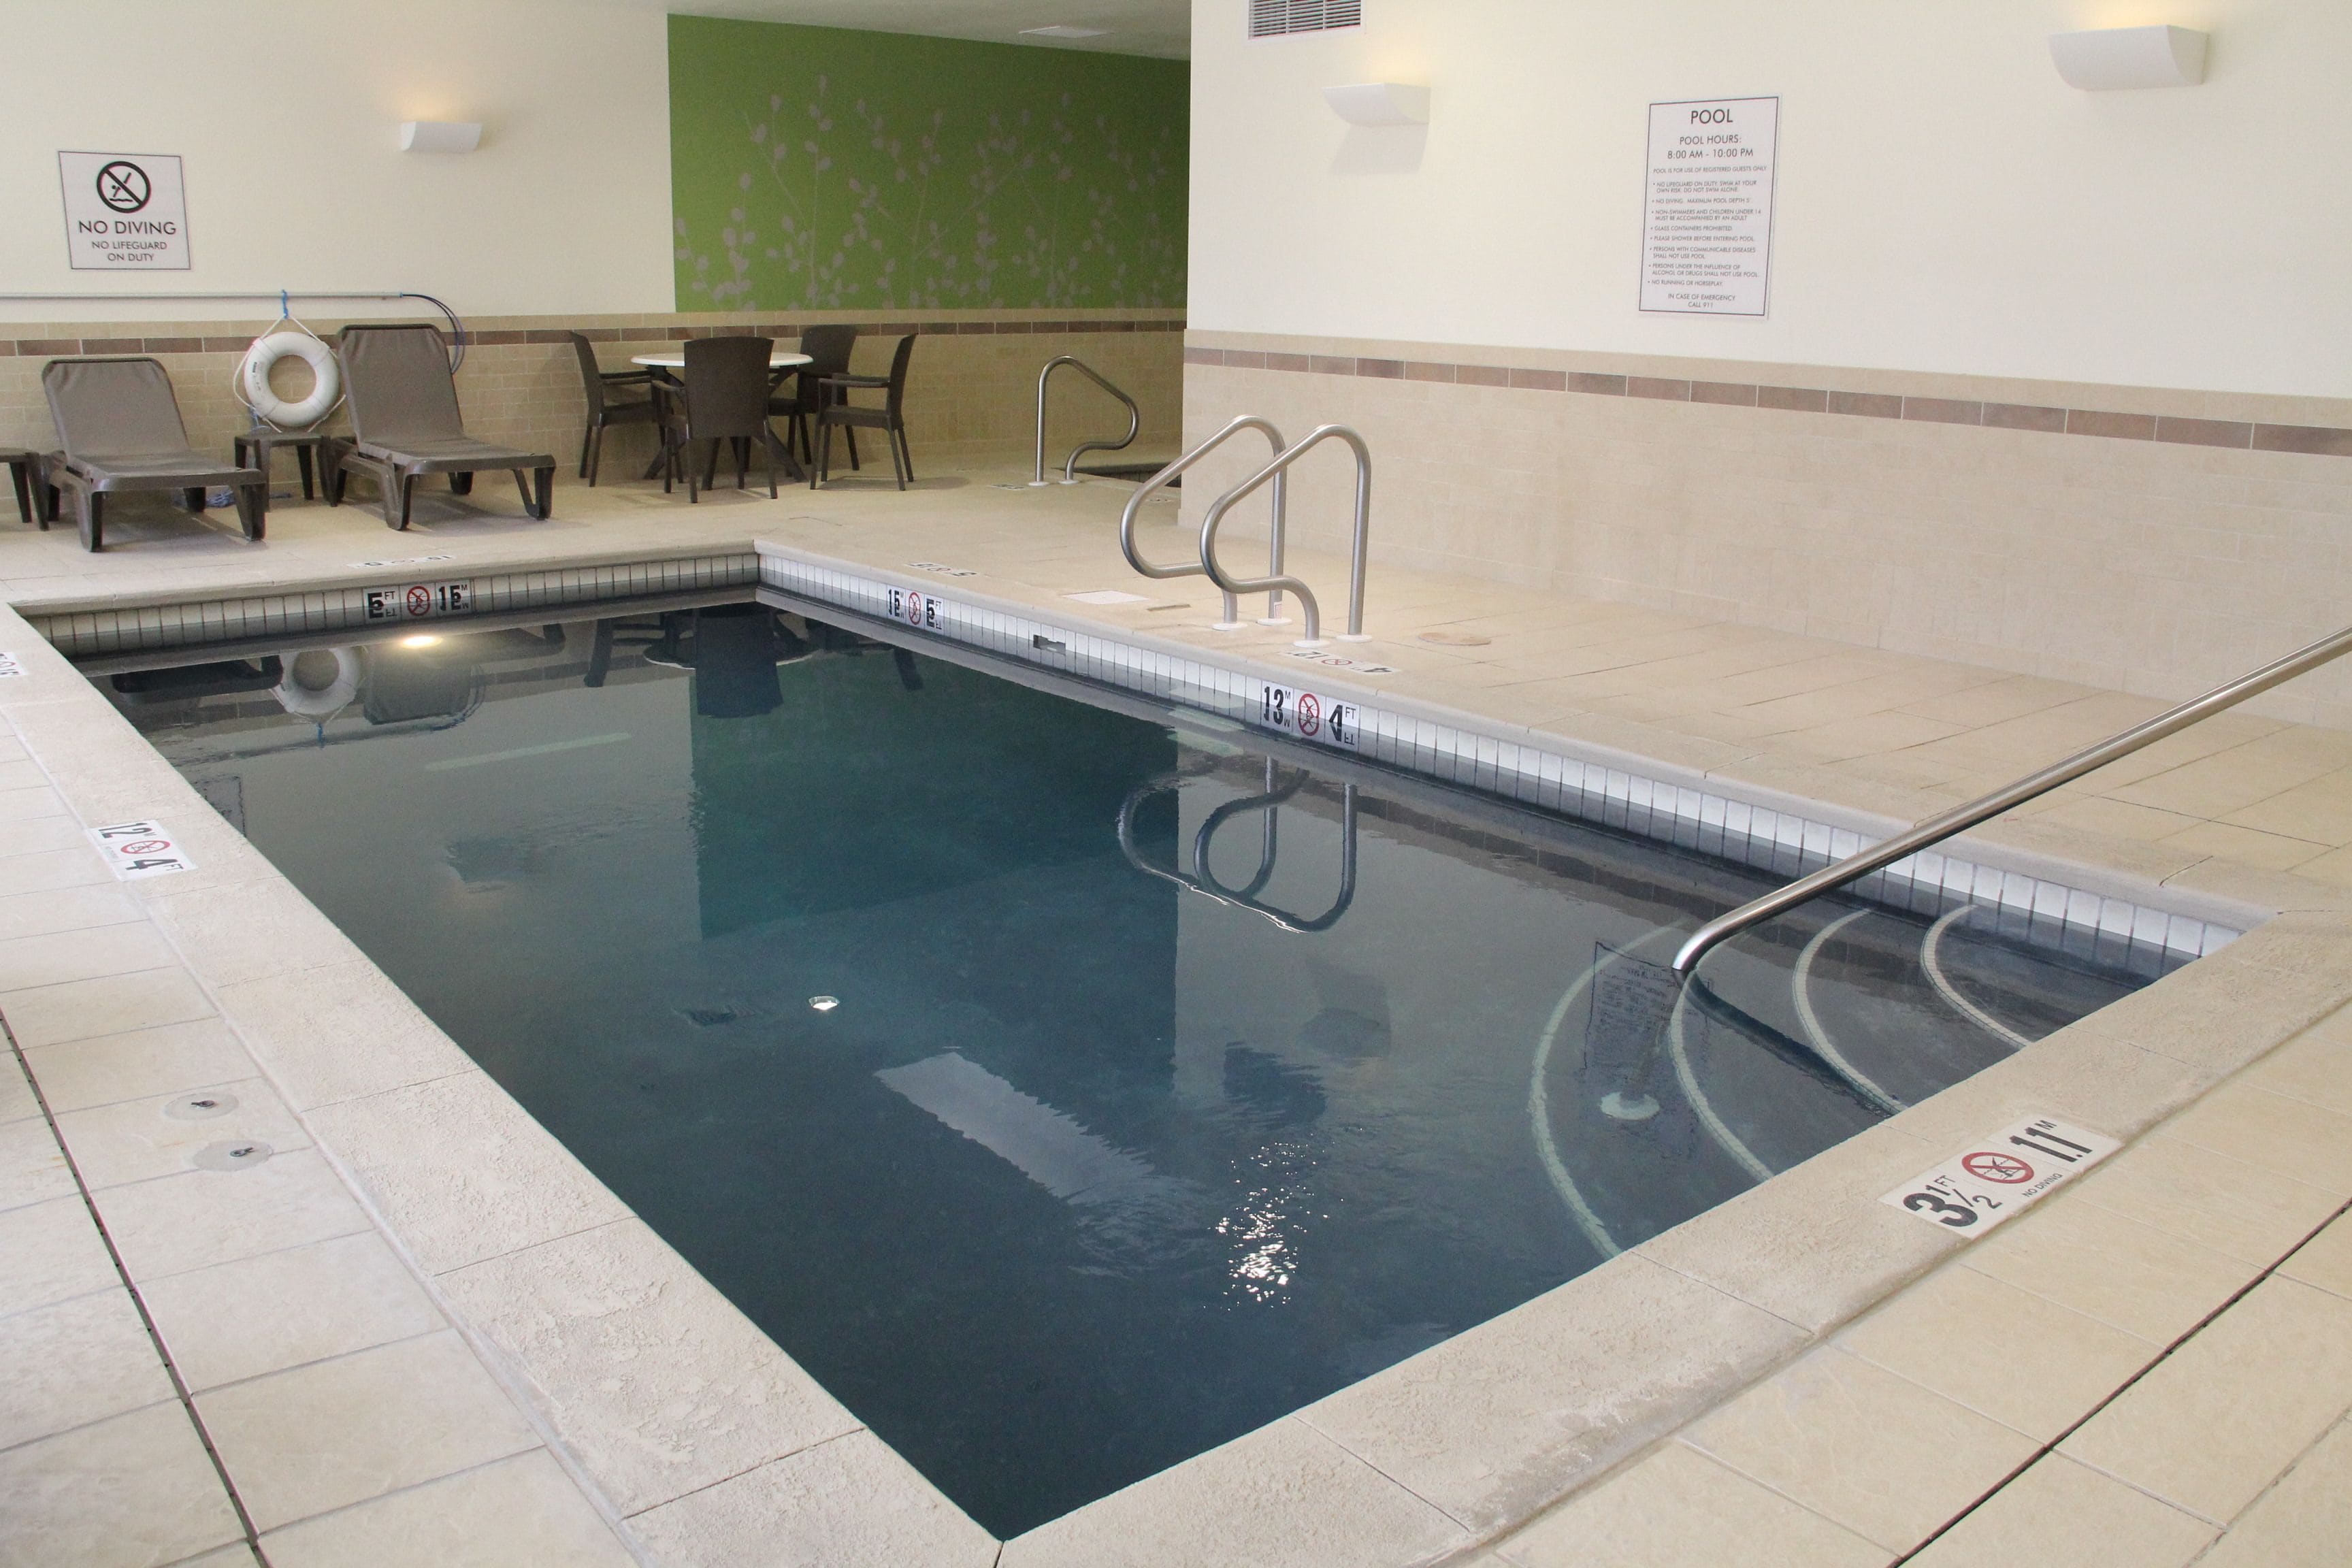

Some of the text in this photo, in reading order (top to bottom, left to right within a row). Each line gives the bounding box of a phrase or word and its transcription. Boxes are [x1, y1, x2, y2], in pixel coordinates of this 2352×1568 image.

[1690, 109, 1733, 125] POOL
[1680, 135, 1742, 145] POOL HOURS:
[1667, 150, 1686, 159] 8:00
[1689, 150, 1703, 158] AM
[1713, 149, 1737, 157] 10:00
[1740, 148, 1754, 157] PM
[78, 220, 176, 235] NO DIVING
[91, 241, 167, 250] NO LIFEGUARD
[108, 253, 125, 261] ON
[385, 591, 395, 600] FT
[1285, 691, 1290, 700] M
[1345, 706, 1356, 719] FT
[125, 859, 178, 870] 4
[2034, 1120, 2057, 1130] M
[1935, 1175, 1956, 1188] FT
[2022, 1173, 2063, 1197] NO DIVING
